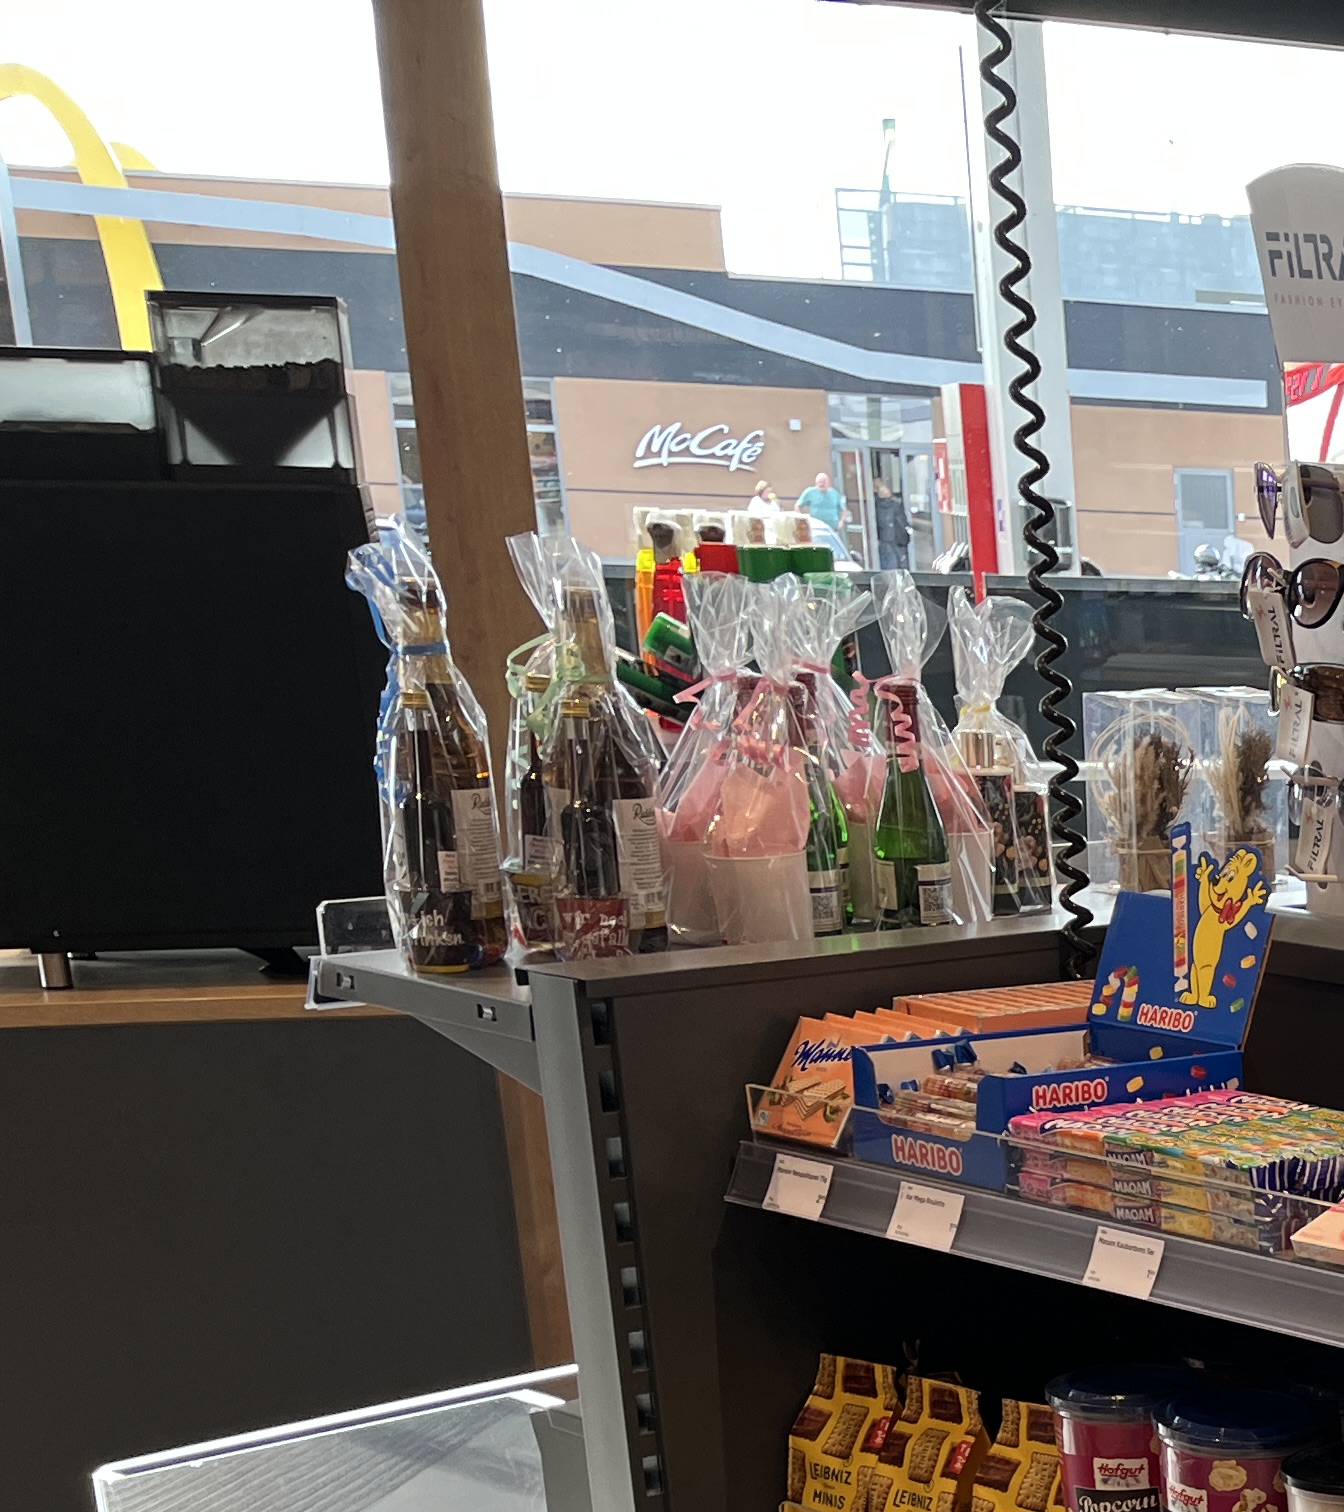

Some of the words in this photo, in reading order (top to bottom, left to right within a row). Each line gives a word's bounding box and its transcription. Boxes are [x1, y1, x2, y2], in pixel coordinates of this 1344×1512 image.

[633, 421, 767, 472] McCafé
[1137, 1003, 1196, 1033] HARIBO
[1032, 1079, 1108, 1108] HARIBO
[890, 1135, 964, 1176] HARIBO
[1113, 1179, 1152, 1197] MAOAM
[1116, 1205, 1156, 1223] MAOAM
[808, 1460, 852, 1486] LEIBNIZ
[1096, 1462, 1146, 1480] Hofgut
[812, 1488, 846, 1511] MINIS
[893, 1488, 933, 1512] LEIBNIZ
[1168, 1484, 1204, 1507] Hofgut
